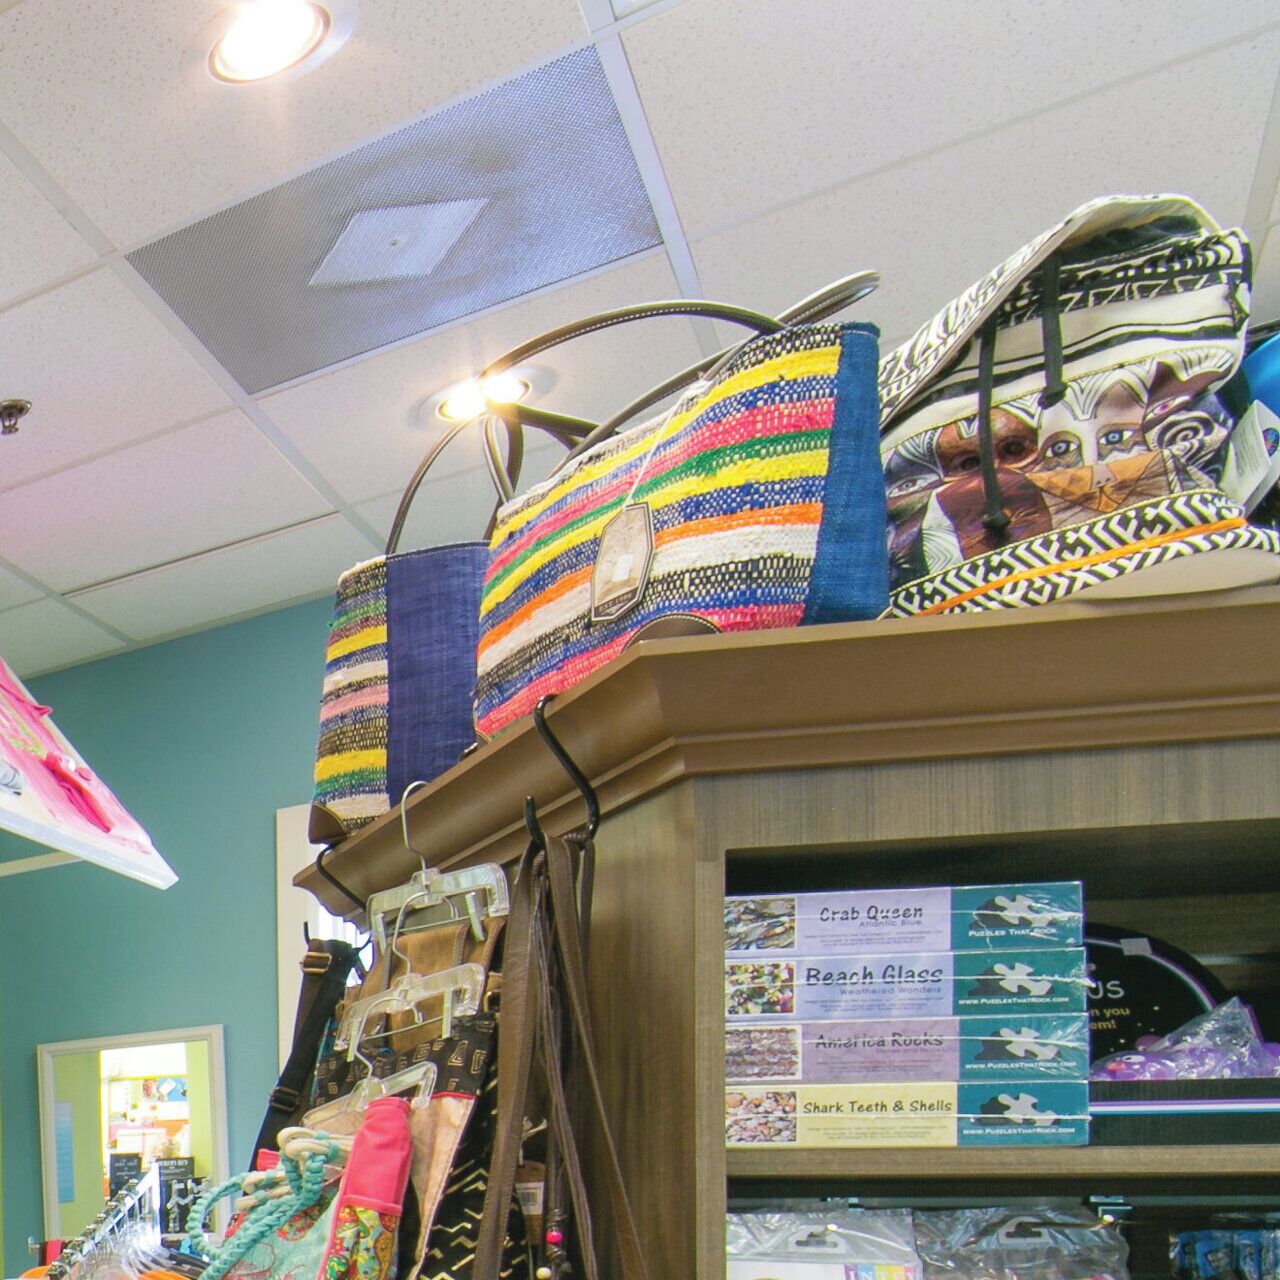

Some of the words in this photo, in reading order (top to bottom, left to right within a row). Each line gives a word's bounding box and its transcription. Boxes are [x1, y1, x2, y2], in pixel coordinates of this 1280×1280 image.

[819, 905, 860, 922] Crab
[866, 904, 924, 920] Queen
[858, 919, 898, 929] Atlantic
[900, 919, 923, 927] Blue
[805, 965, 874, 987] Beach
[880, 964, 945, 985] Glass
[838, 986, 895, 997] Weathered
[896, 985, 943, 996] Wonders
[1102, 1007, 1131, 1018] you
[891, 1031, 944, 1048] Rocks
[803, 1101, 845, 1115] Shark
[848, 1100, 888, 1113] Teeth
[892, 1099, 905, 1111] &
[909, 1099, 953, 1113] Shells
